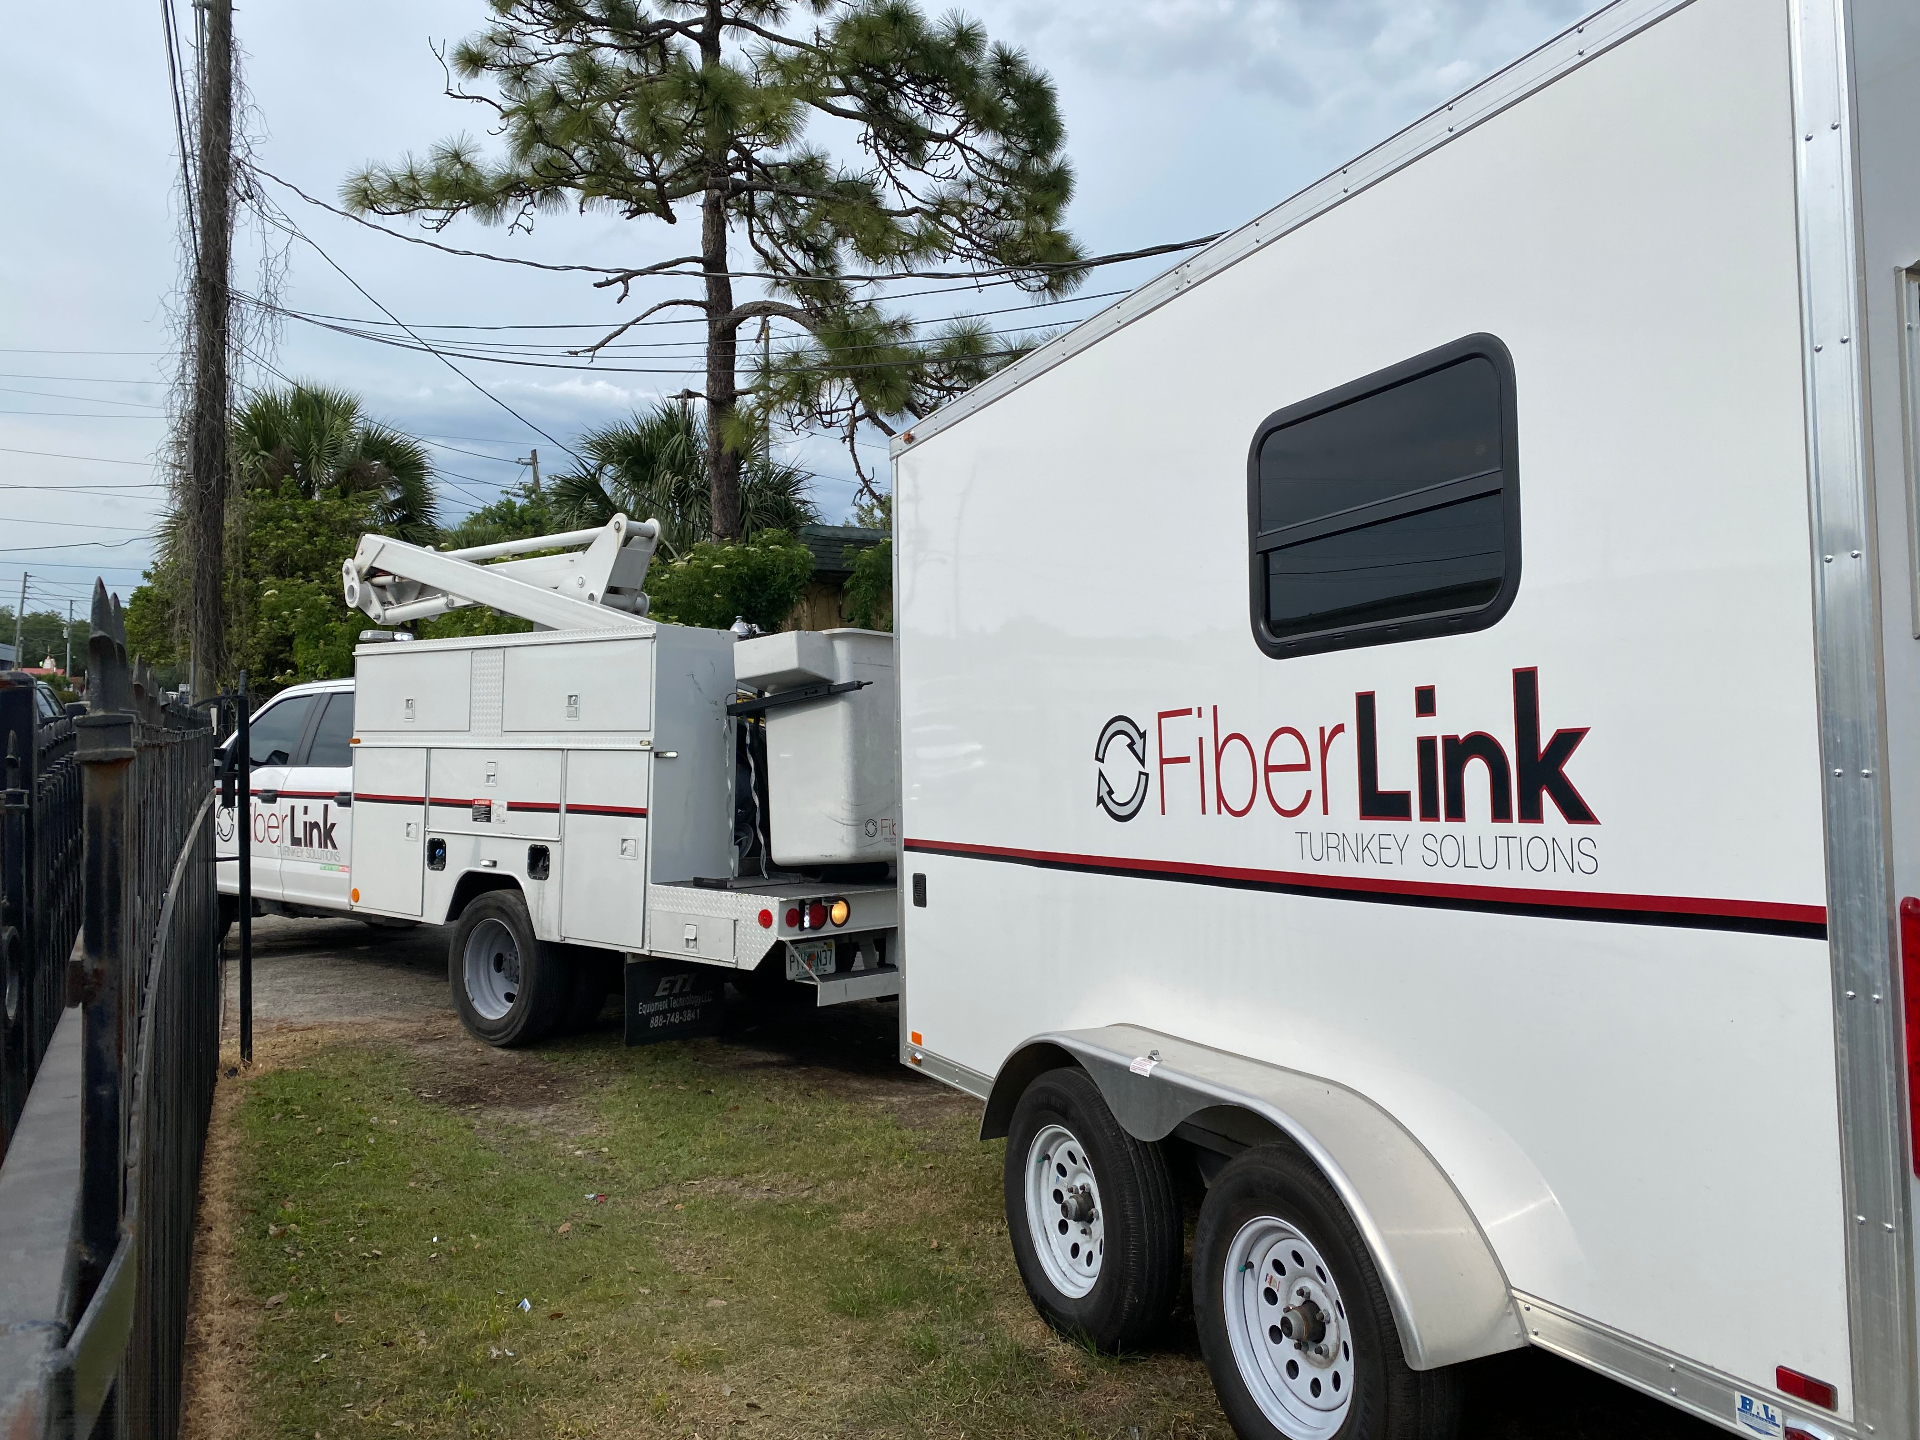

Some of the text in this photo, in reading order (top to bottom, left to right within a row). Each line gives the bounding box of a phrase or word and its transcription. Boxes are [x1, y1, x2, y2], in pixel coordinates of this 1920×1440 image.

[1157, 665, 1602, 825] FiberLink
[249, 803, 339, 851] iberLink
[276, 845, 341, 863] TURNKEY SOLUTIONS
[1294, 830, 1600, 876] TURNKEY SOLUTIONS
[653, 973, 698, 997] ETI
[638, 998, 669, 1016] Equipment
